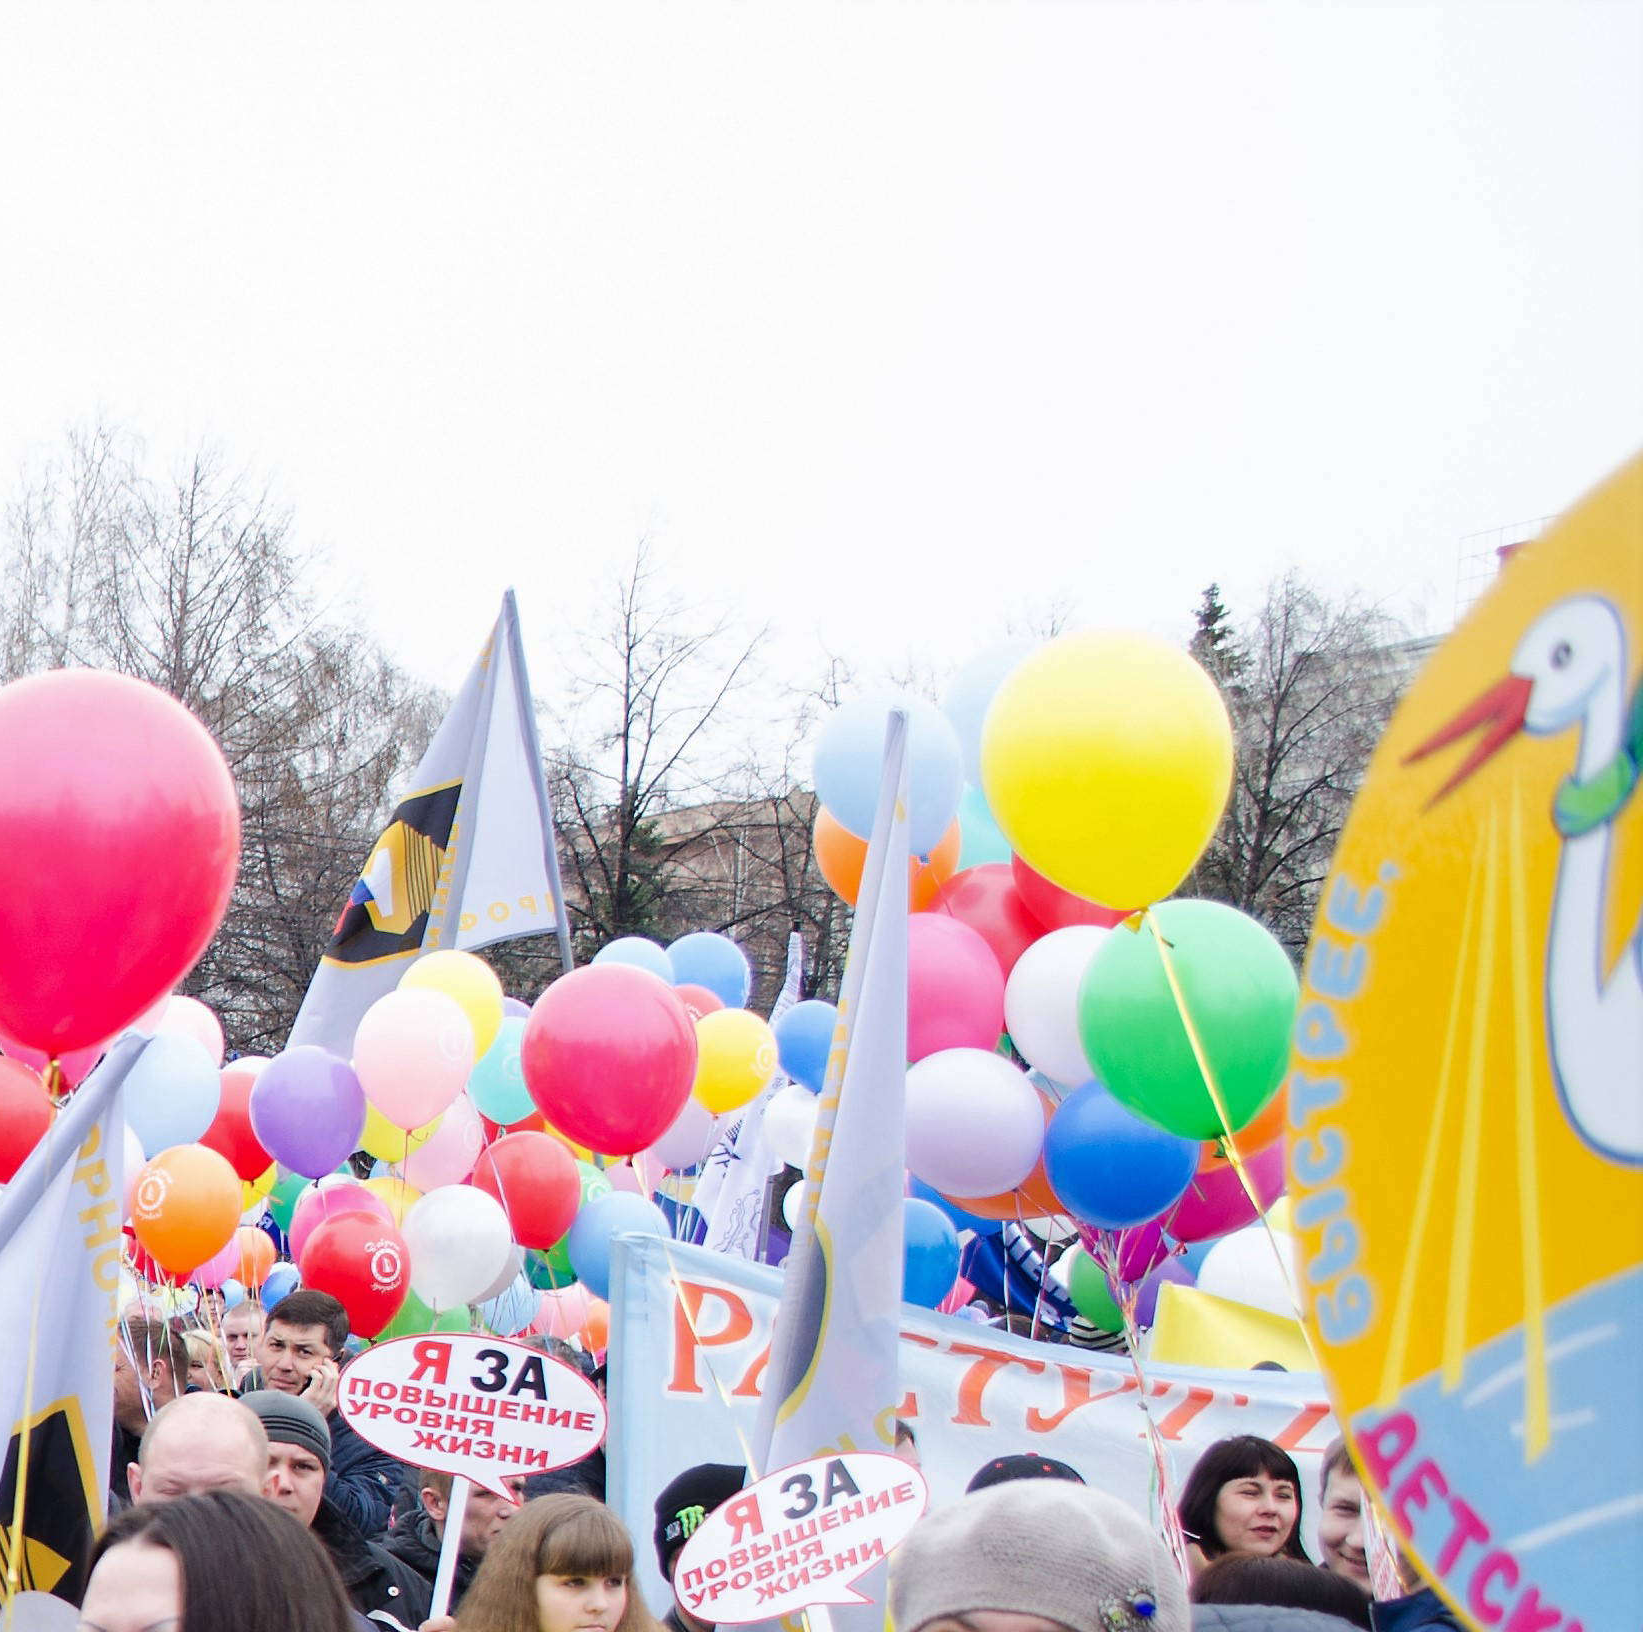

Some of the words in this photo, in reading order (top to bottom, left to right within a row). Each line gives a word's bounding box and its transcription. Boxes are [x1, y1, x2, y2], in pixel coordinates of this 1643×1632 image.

[409, 1341, 451, 1384] Я
[471, 1350, 547, 1400] ЗА
[347, 1399, 494, 1436] УРОВНЯ
[348, 1376, 596, 1432] ПОВЫШЕНИЕ
[411, 1429, 550, 1468] ЖИЗНИ
[724, 1494, 764, 1544] Я
[781, 1459, 862, 1518] ЗА
[682, 1481, 917, 1589] ПОВЫШЕНИЕ
[687, 1541, 824, 1609] УРОВНЯ
[754, 1538, 885, 1605] ЖИЗНИ
